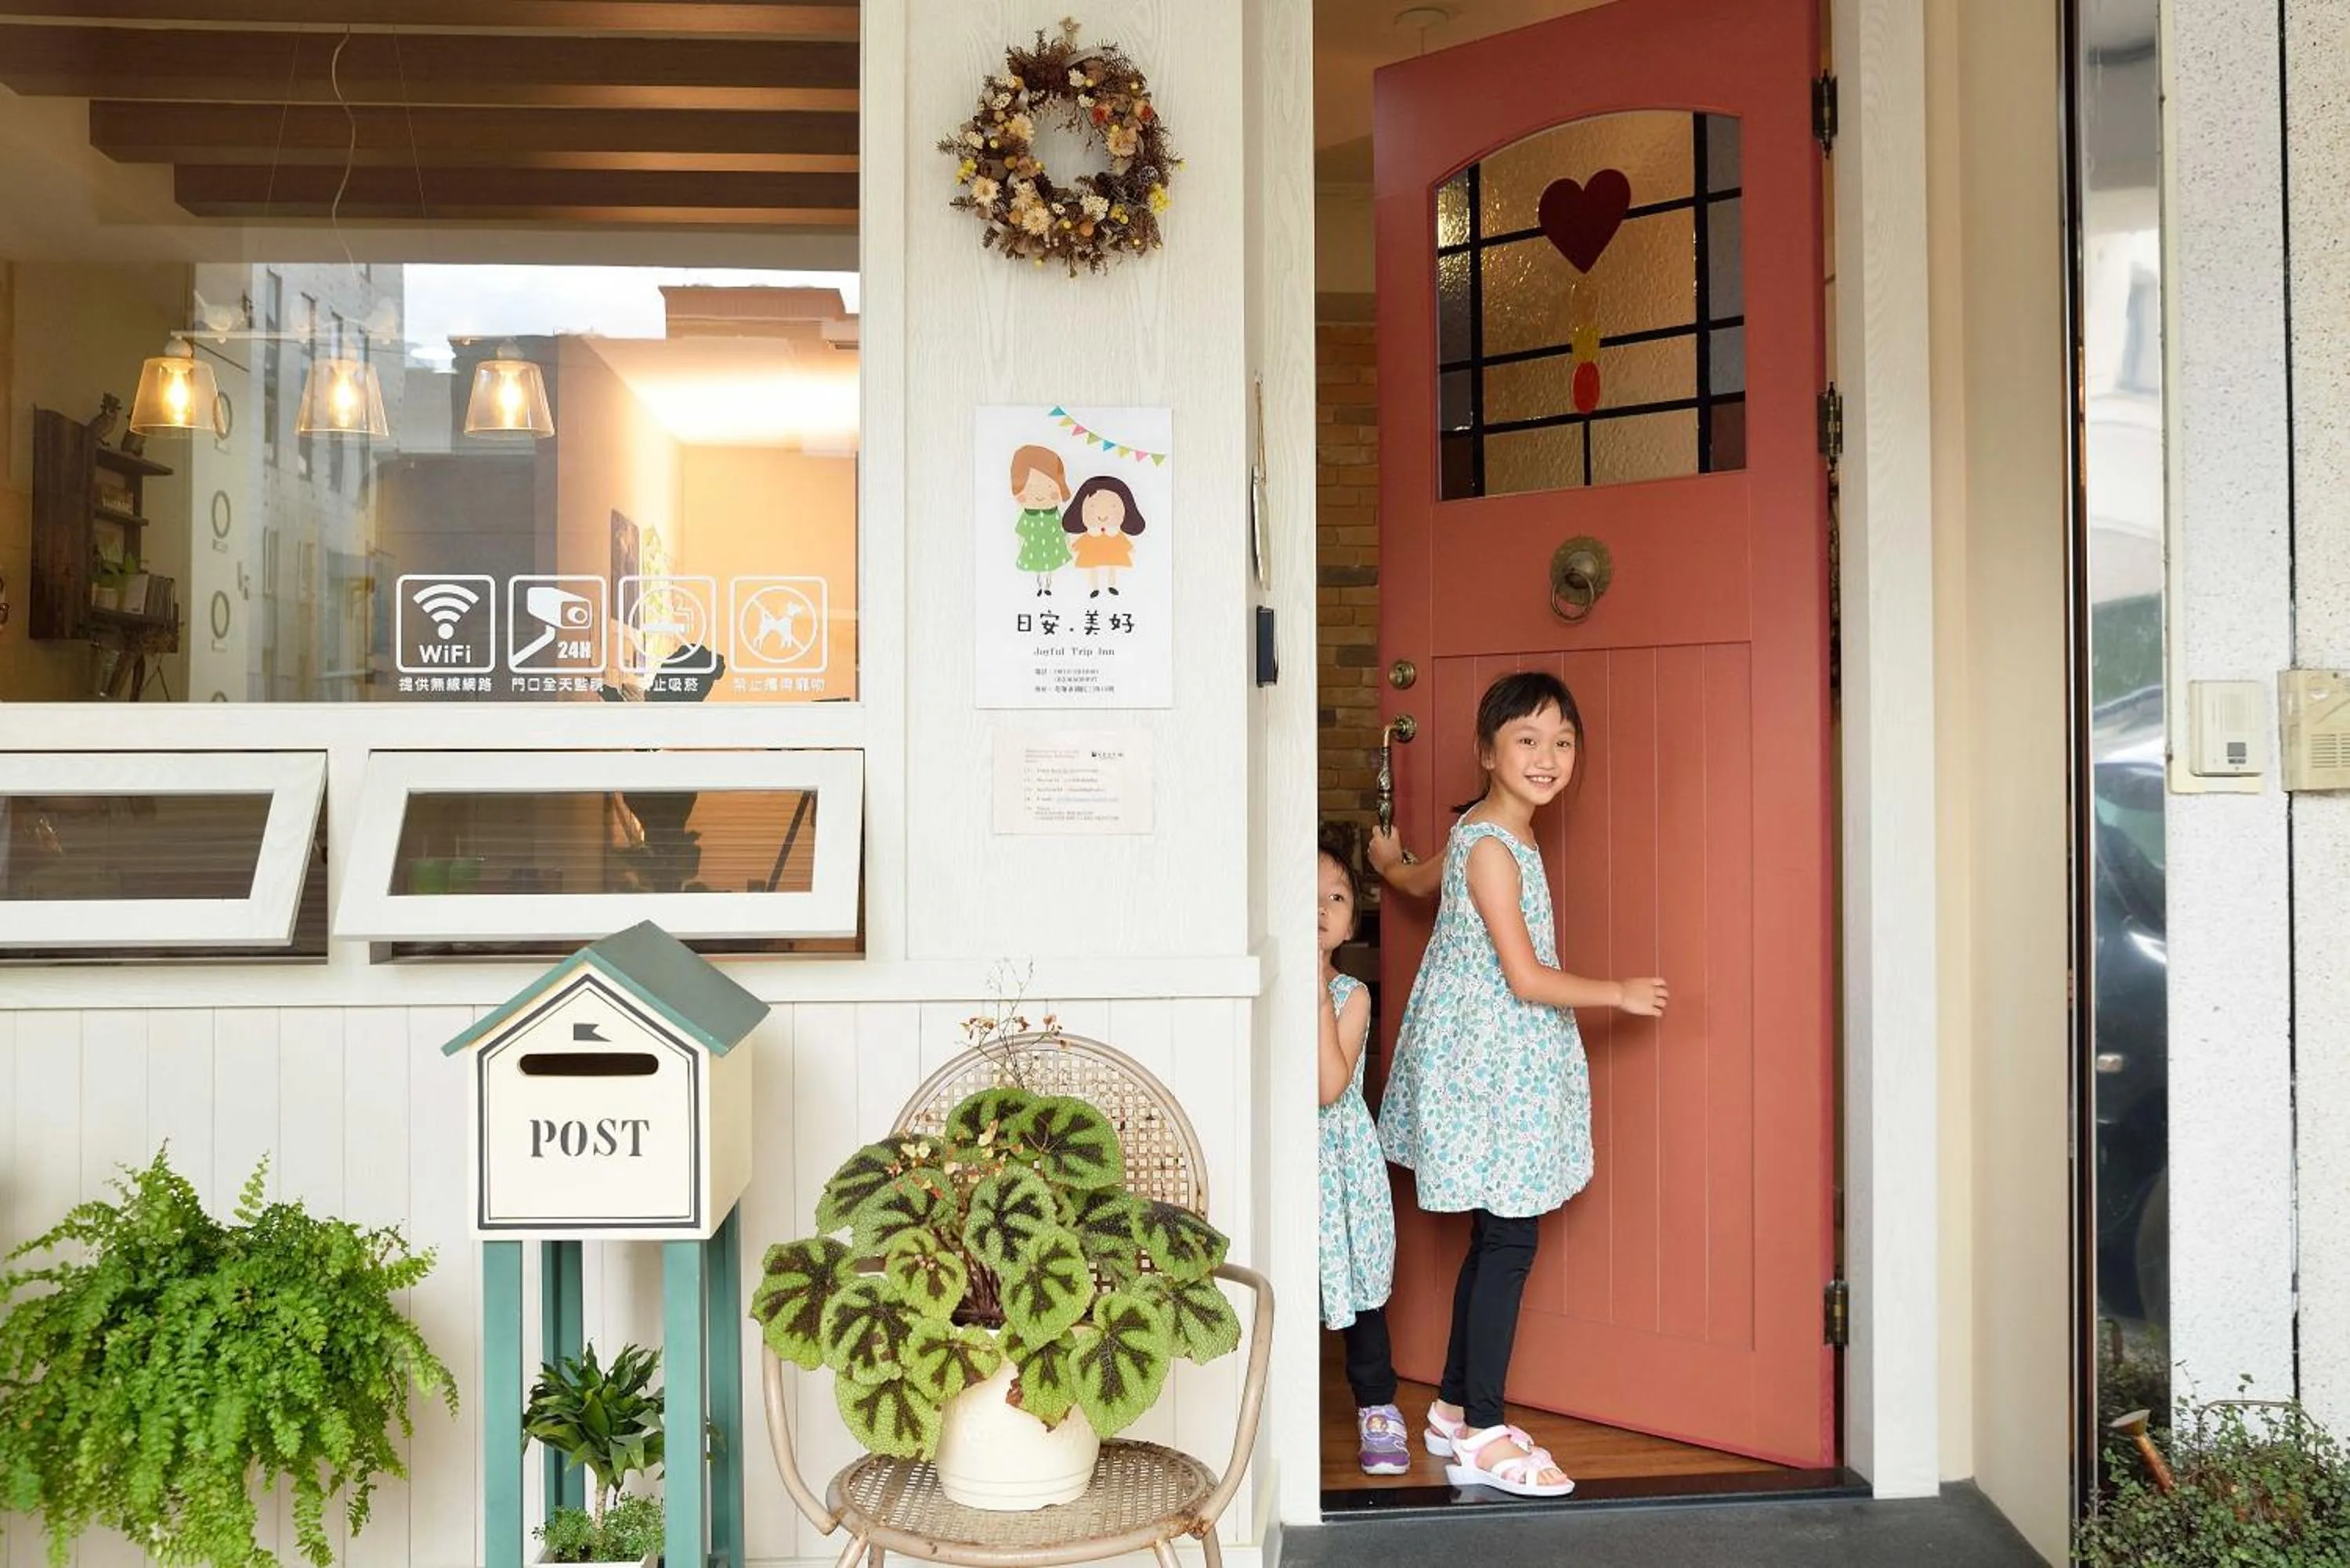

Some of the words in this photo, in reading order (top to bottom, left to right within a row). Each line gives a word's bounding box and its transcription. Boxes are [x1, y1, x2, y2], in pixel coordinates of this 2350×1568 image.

[419, 645, 471, 663] WiFi
[557, 641, 591, 659] 24H
[1034, 646, 1065, 657] Joyful
[1072, 646, 1093, 658] Trip
[1097, 646, 1115, 656] Inn
[399, 677, 492, 692] 提供無線網路
[512, 677, 604, 692] 門口全天監視
[638, 677, 699, 692] 止吸菸
[530, 1118, 649, 1158] POST
